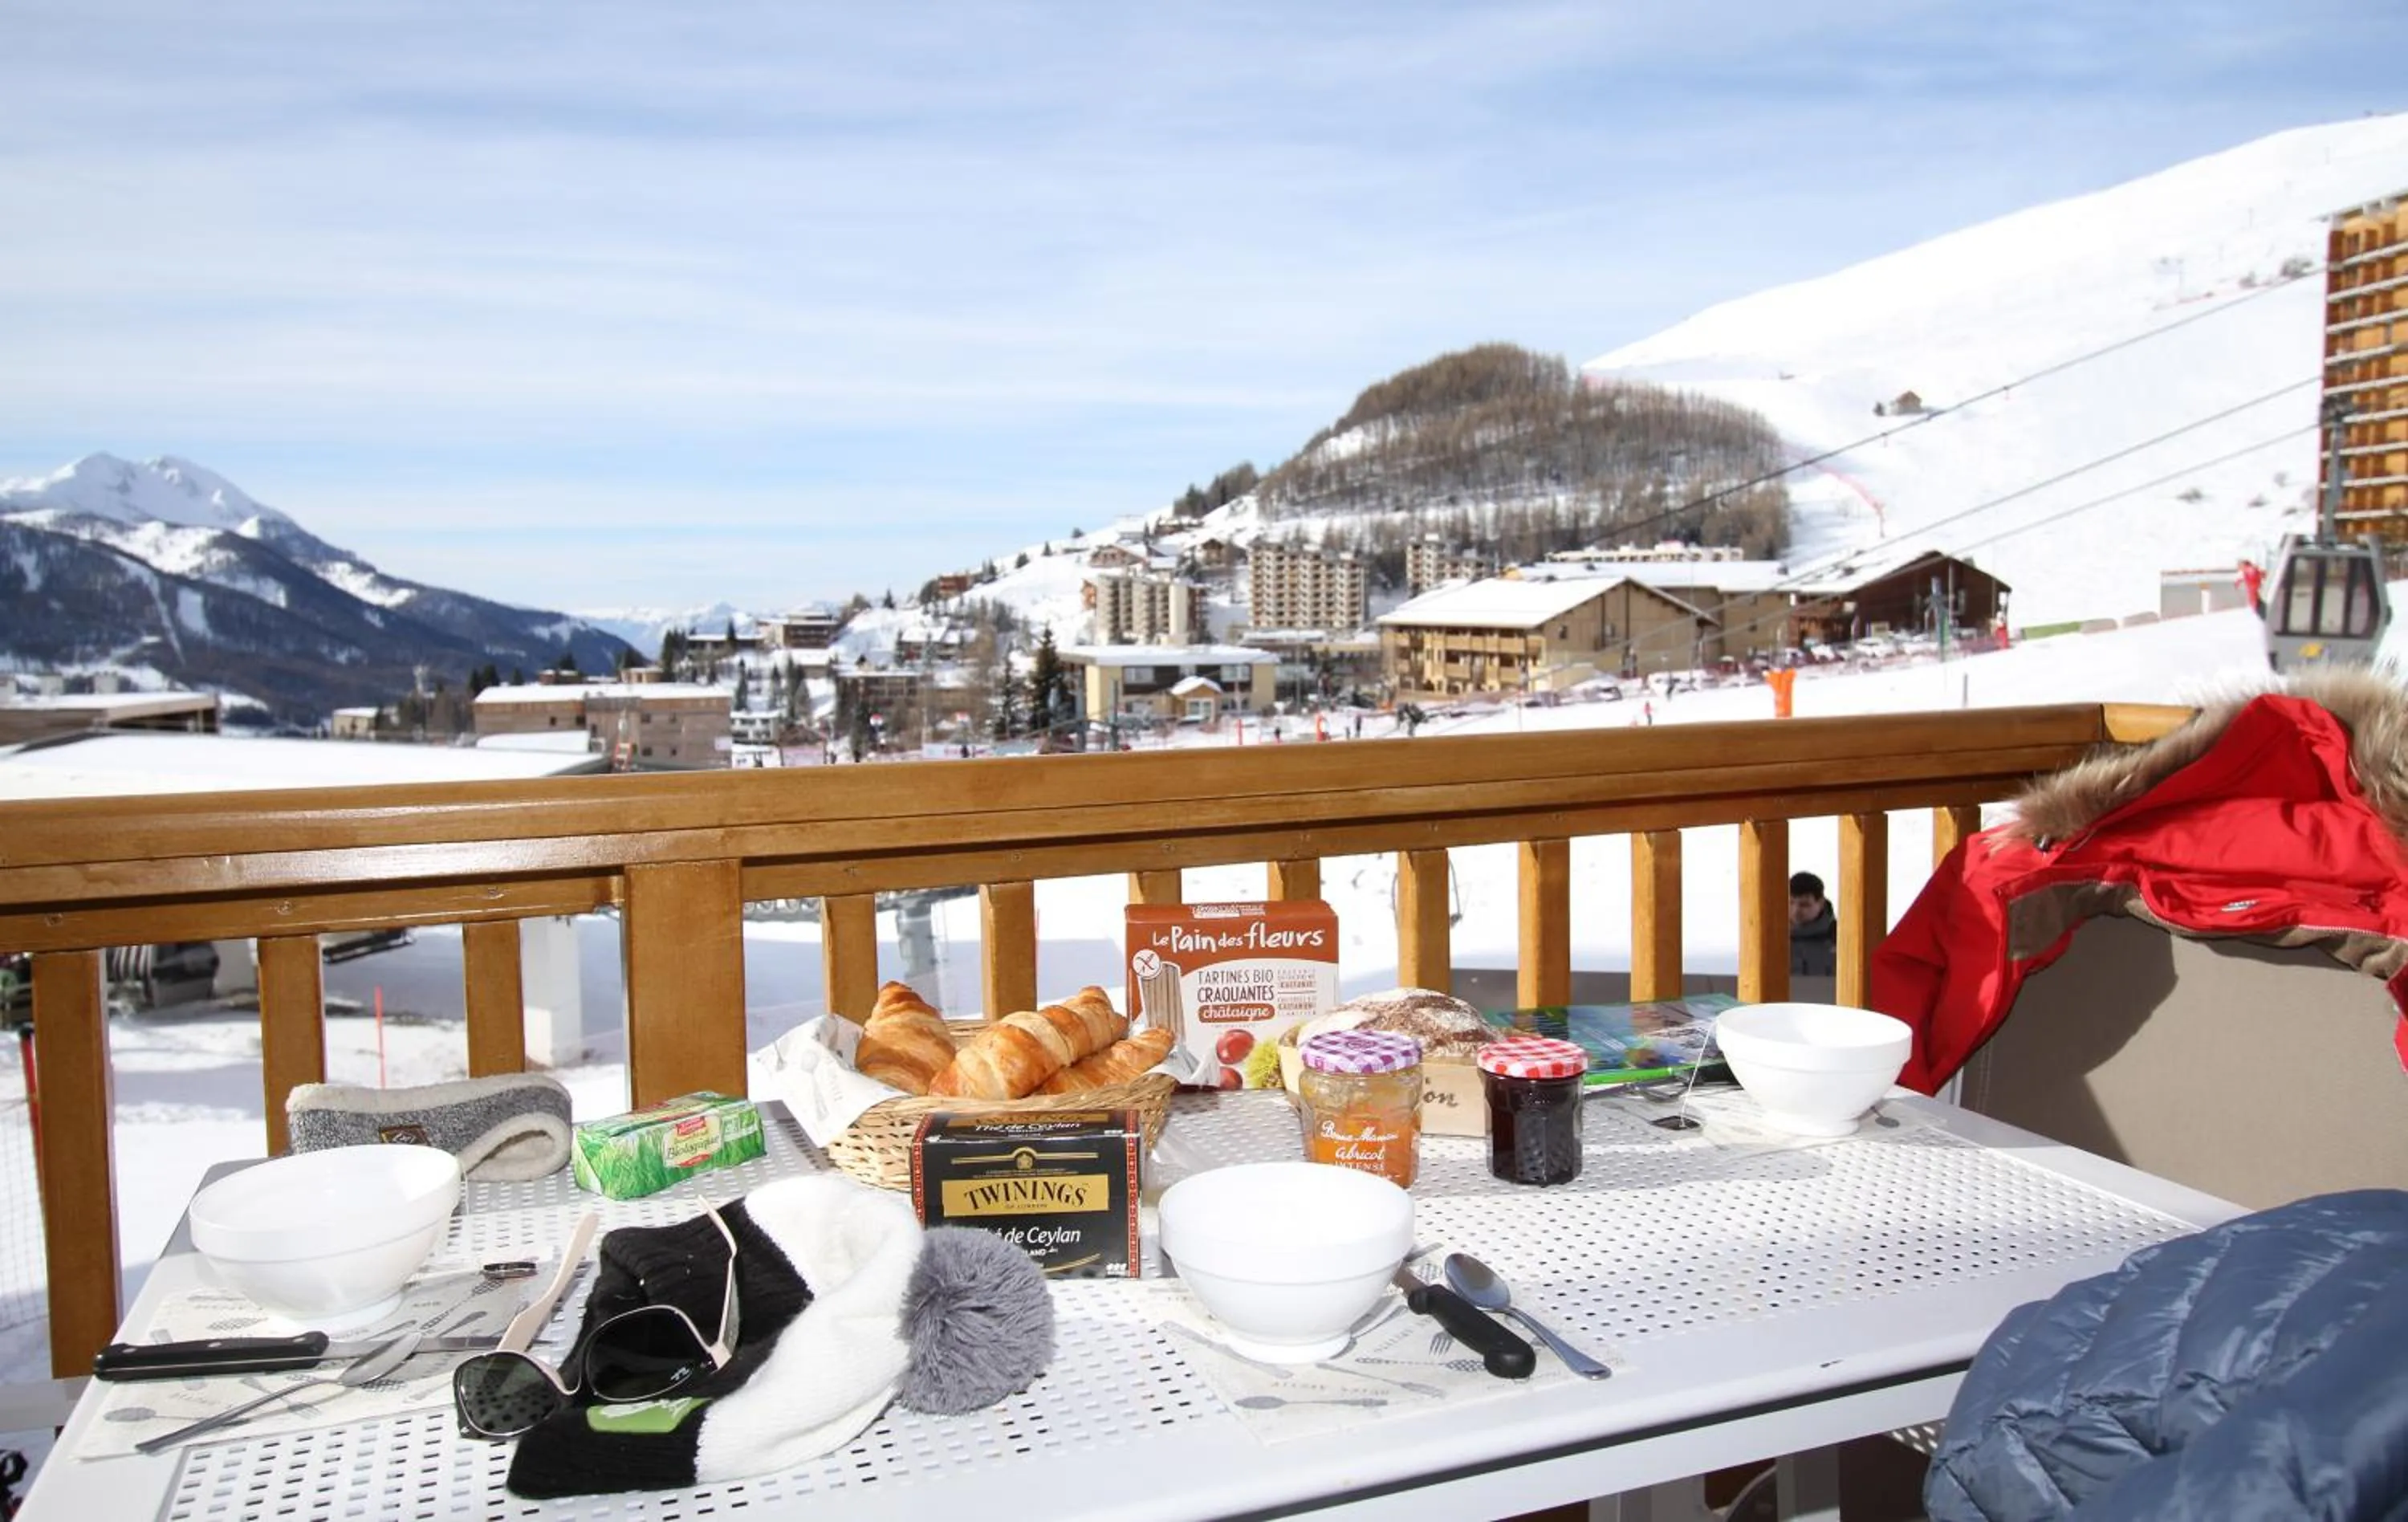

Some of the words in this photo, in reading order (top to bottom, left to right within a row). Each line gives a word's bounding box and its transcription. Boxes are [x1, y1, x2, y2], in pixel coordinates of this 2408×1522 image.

[1153, 932, 1169, 946] Le
[1171, 926, 1216, 953] Pain
[1218, 931, 1243, 946] des
[1244, 922, 1324, 950] fleurs
[1198, 970, 1250, 985] TARTINES
[1252, 968, 1274, 983] BIO
[1197, 986, 1275, 1003] CRAQUANTES
[1203, 1003, 1270, 1021] châtaigne
[964, 1179, 1088, 1211] TWININGS
[1004, 1227, 1025, 1243] de
[1027, 1226, 1081, 1247] Ceylan
